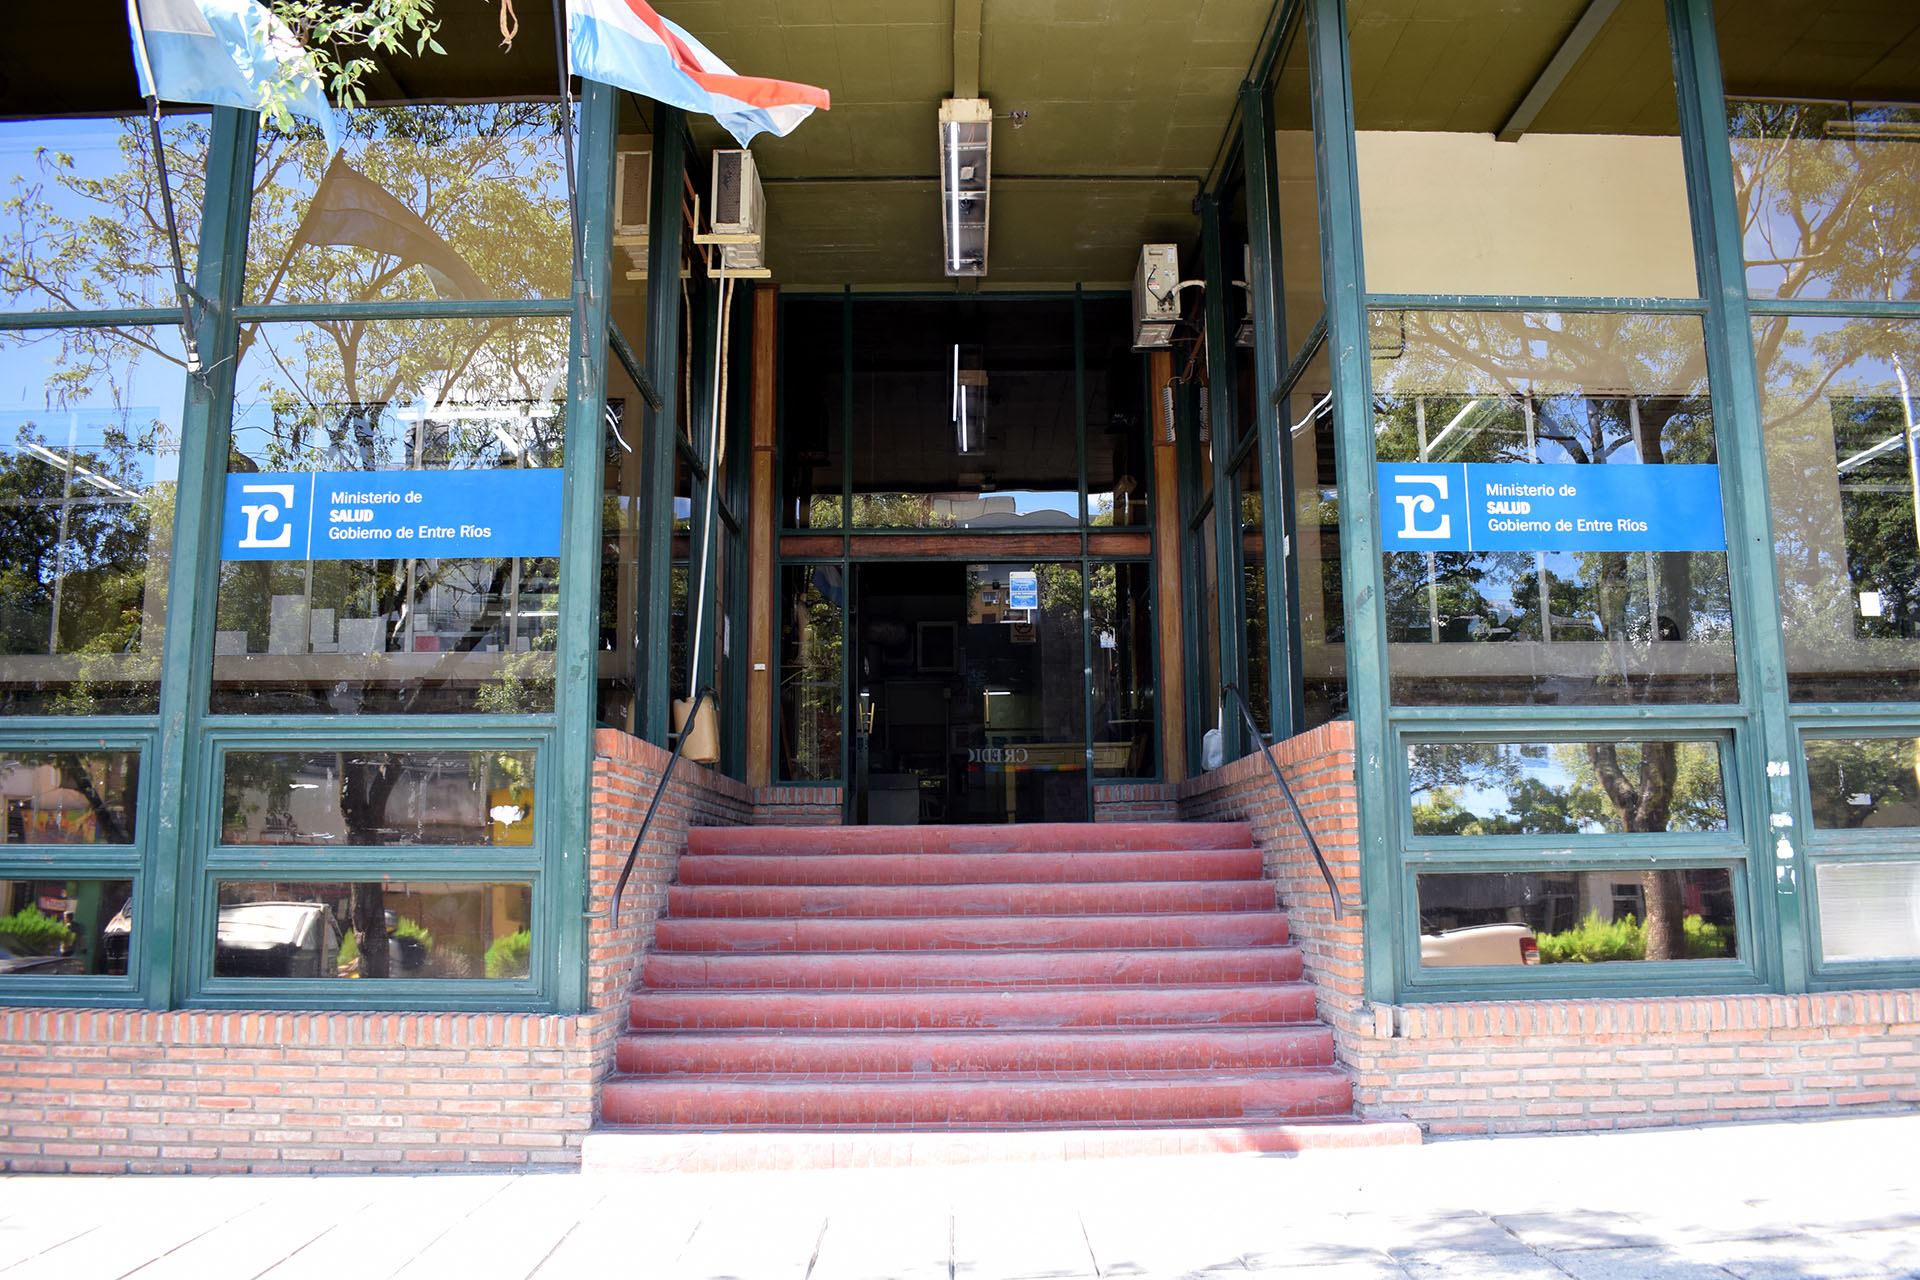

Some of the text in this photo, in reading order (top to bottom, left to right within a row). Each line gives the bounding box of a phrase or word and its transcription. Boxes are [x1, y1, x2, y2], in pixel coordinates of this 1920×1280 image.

[331, 490, 423, 504] Ministerio de
[1486, 483, 1577, 497] Ministerio de
[1486, 501, 1532, 515] SALUD
[329, 509, 374, 523] SALUD
[328, 523, 492, 541] Gobierno de Entre Ríos
[1488, 517, 1649, 533] Gobierno de Entre Ríos
